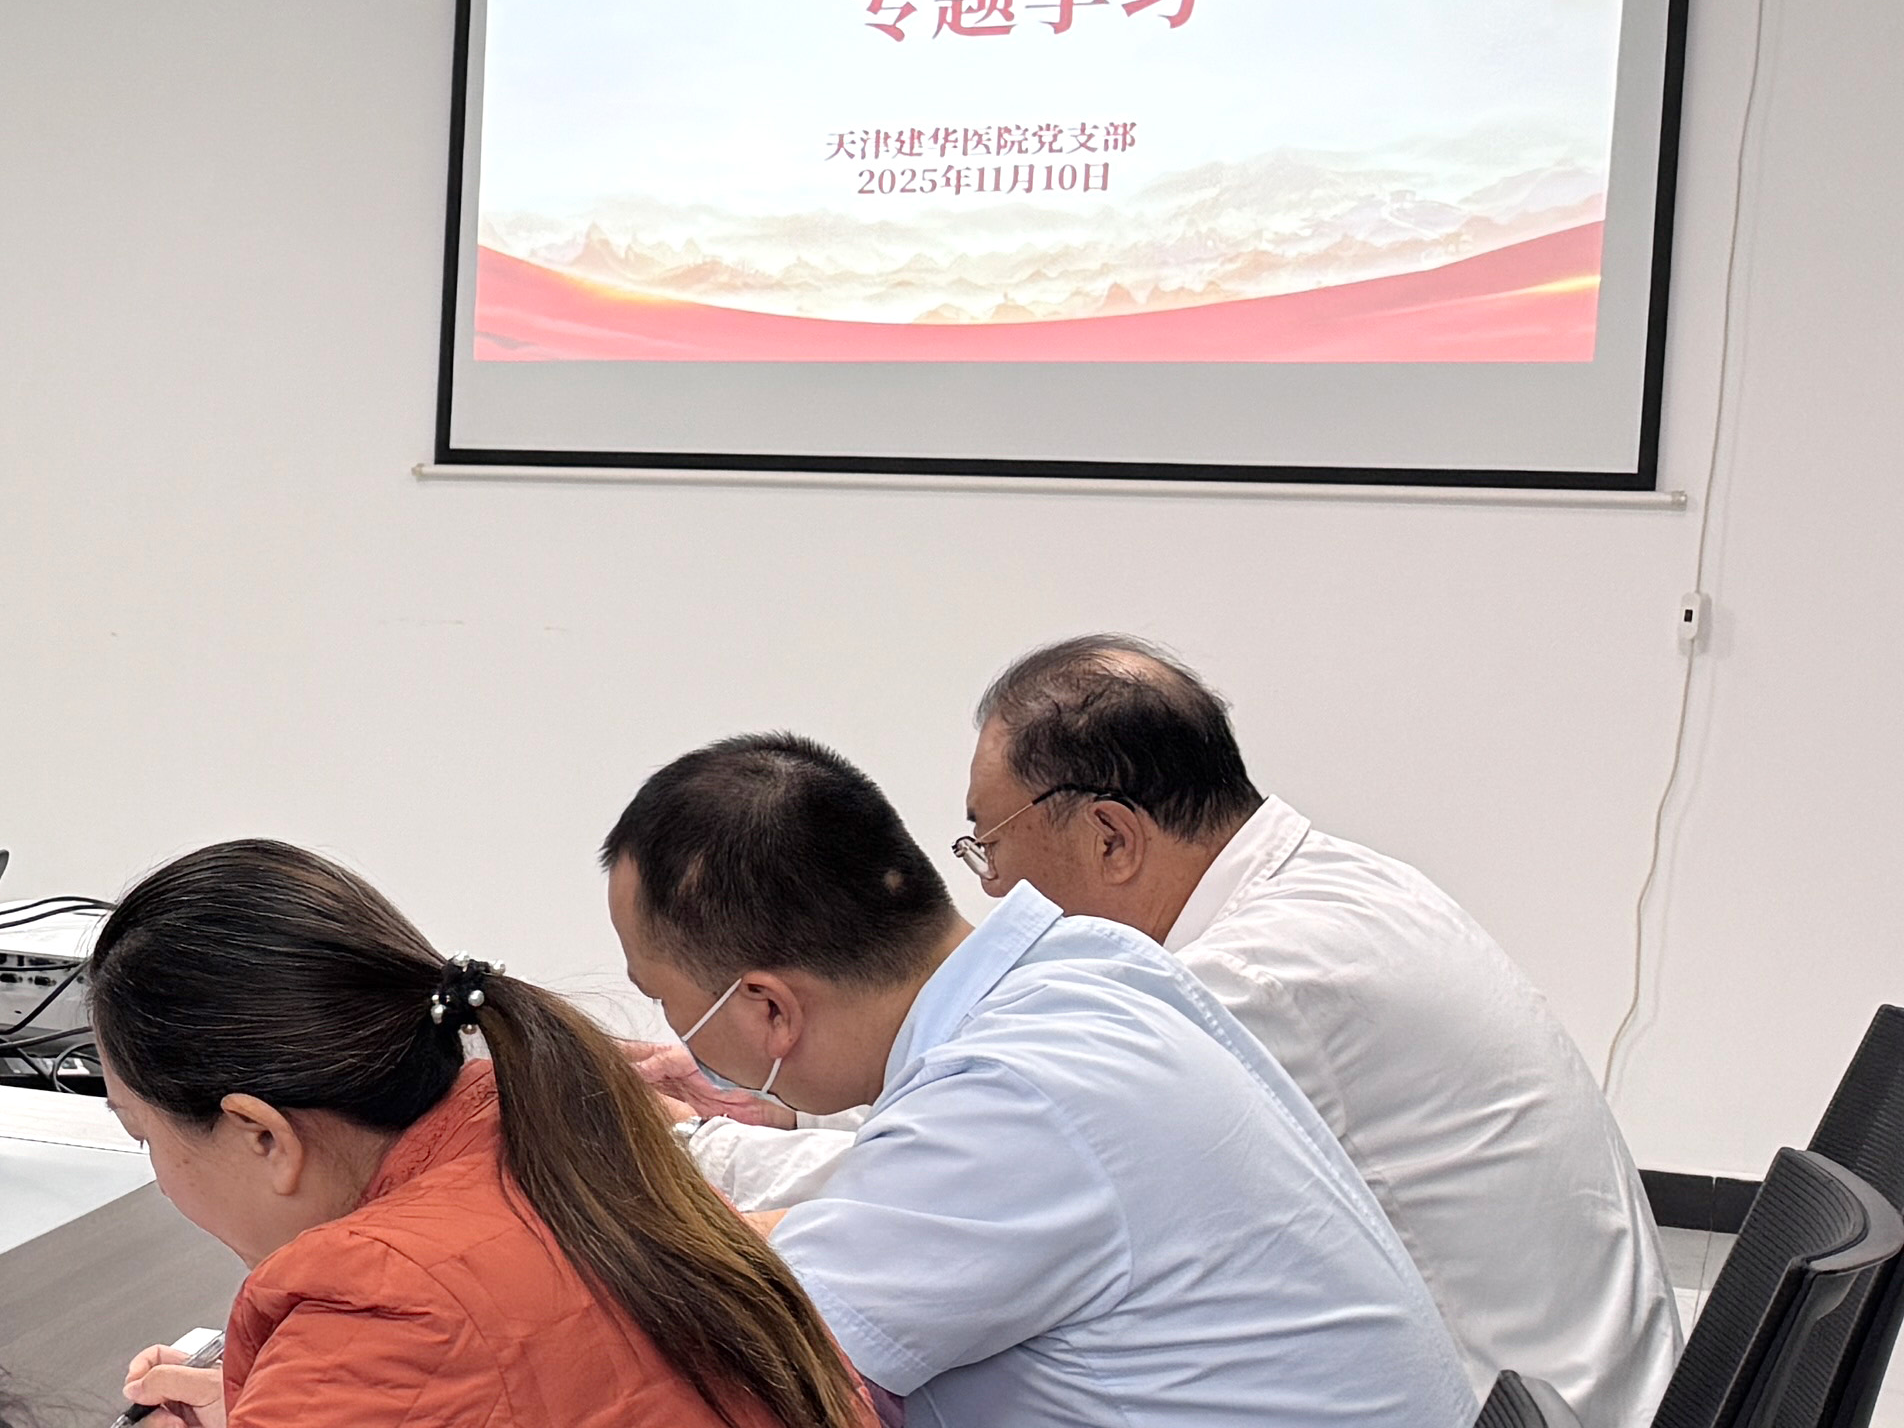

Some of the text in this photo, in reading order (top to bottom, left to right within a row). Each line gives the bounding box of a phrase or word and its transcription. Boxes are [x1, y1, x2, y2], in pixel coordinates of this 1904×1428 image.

[824, 122, 1137, 161] 天津建华医院党支部
[857, 162, 1110, 195] 2025年11月10日
